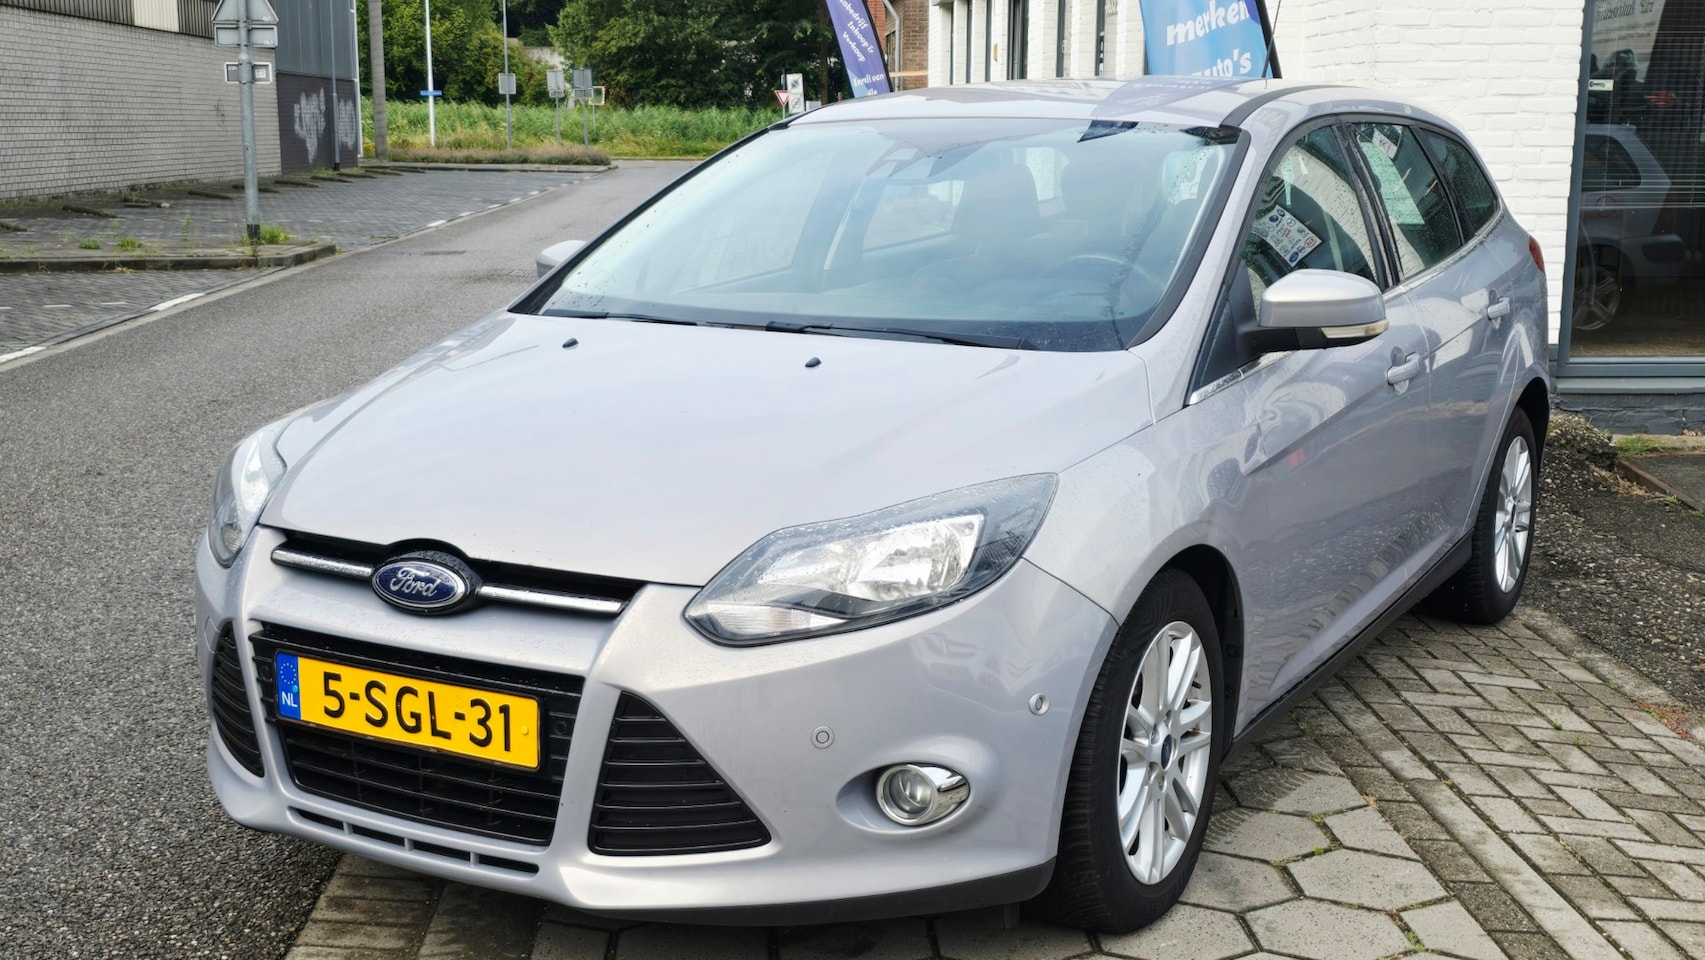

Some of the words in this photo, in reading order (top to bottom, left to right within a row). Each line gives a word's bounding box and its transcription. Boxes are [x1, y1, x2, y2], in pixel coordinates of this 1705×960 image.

[847, 21, 869, 48] Inkoop
[867, 45, 875, 53] &
[1166, 0, 1250, 46] merken
[1192, 48, 1252, 77] uto's
[389, 567, 438, 598] Ford
[281, 691, 298, 708] NL
[322, 671, 511, 752] 5-SGL-31
